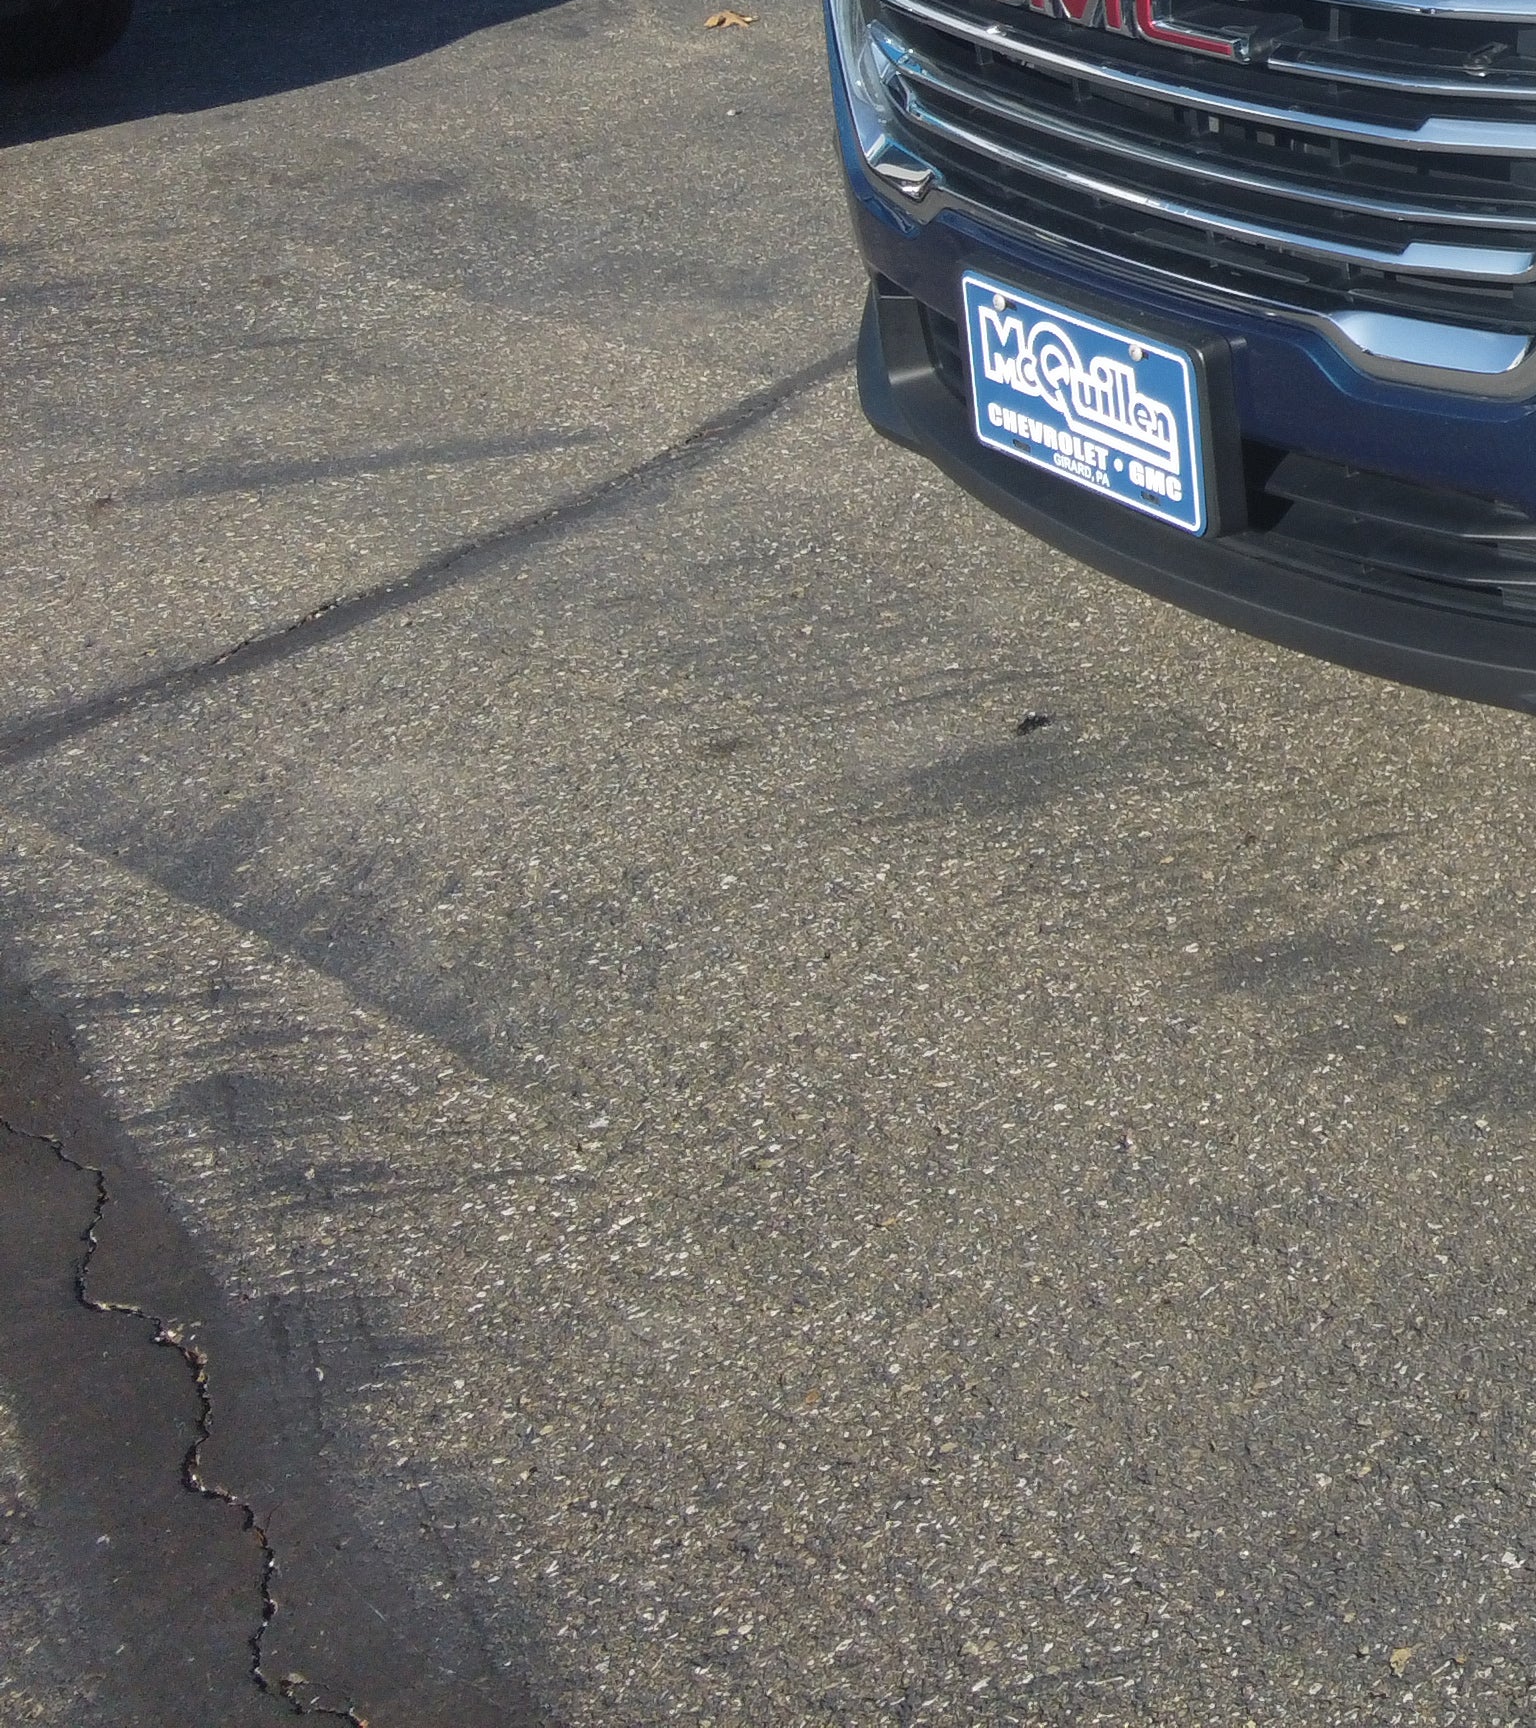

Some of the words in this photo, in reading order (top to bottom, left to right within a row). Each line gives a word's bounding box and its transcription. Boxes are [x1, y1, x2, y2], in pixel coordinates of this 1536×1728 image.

[978, 305, 1180, 475] McQuillen
[988, 402, 1109, 471] CHEVROLET
[1128, 459, 1182, 502] GMC
[1053, 452, 1095, 483] GIRARD,
[1095, 471, 1110, 488] PA
